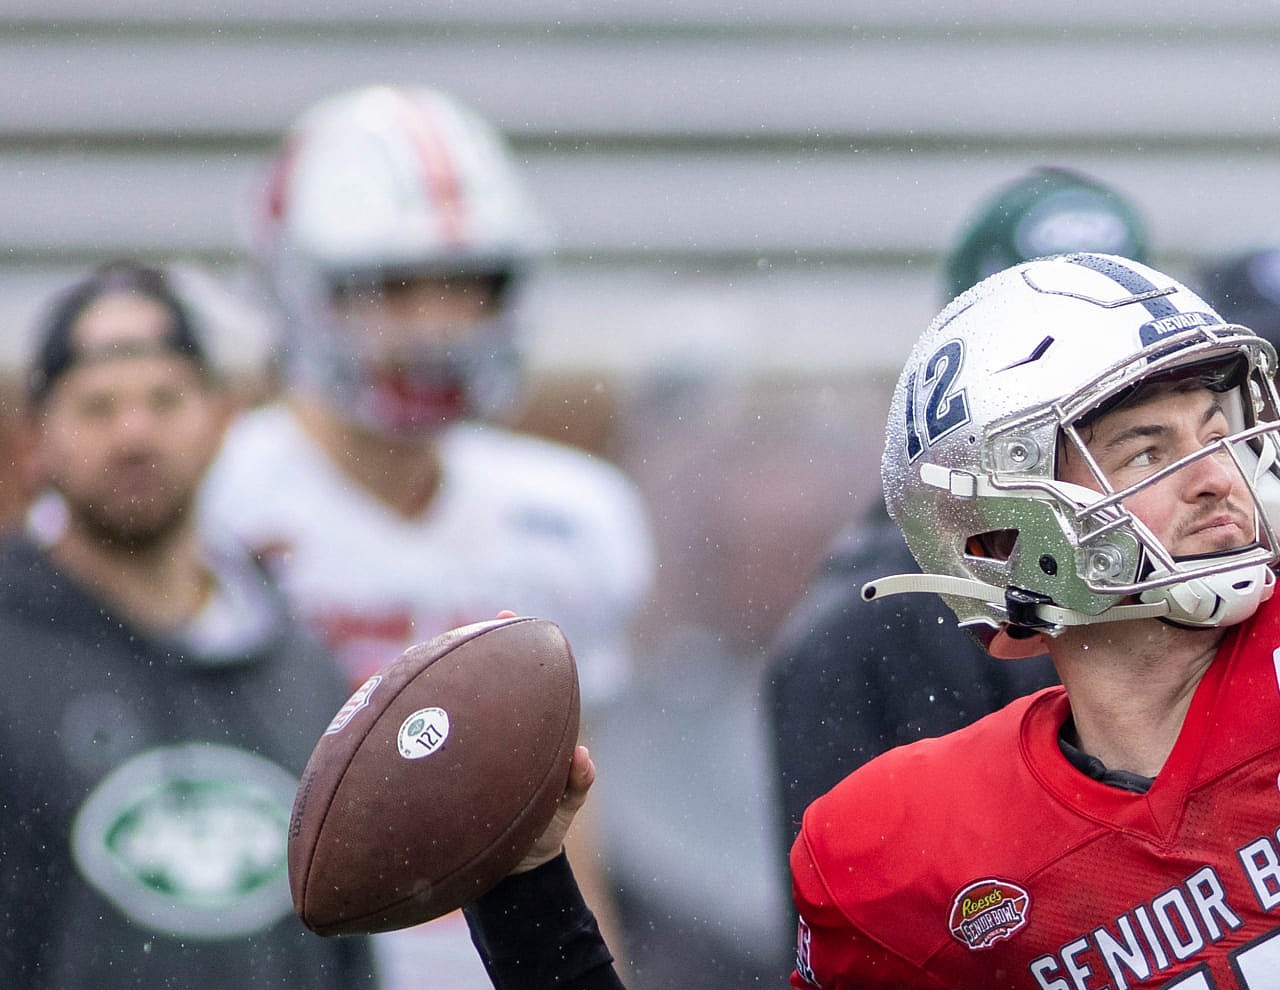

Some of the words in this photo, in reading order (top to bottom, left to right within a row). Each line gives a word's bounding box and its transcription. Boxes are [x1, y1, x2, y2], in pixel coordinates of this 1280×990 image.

[1151, 312, 1207, 335] NEVADA
[904, 337, 971, 466] 12
[415, 723, 443, 750] 127
[962, 888, 1002, 918] Reese's
[964, 914, 995, 943] SENIOR
[991, 901, 1020, 926] BOWL
